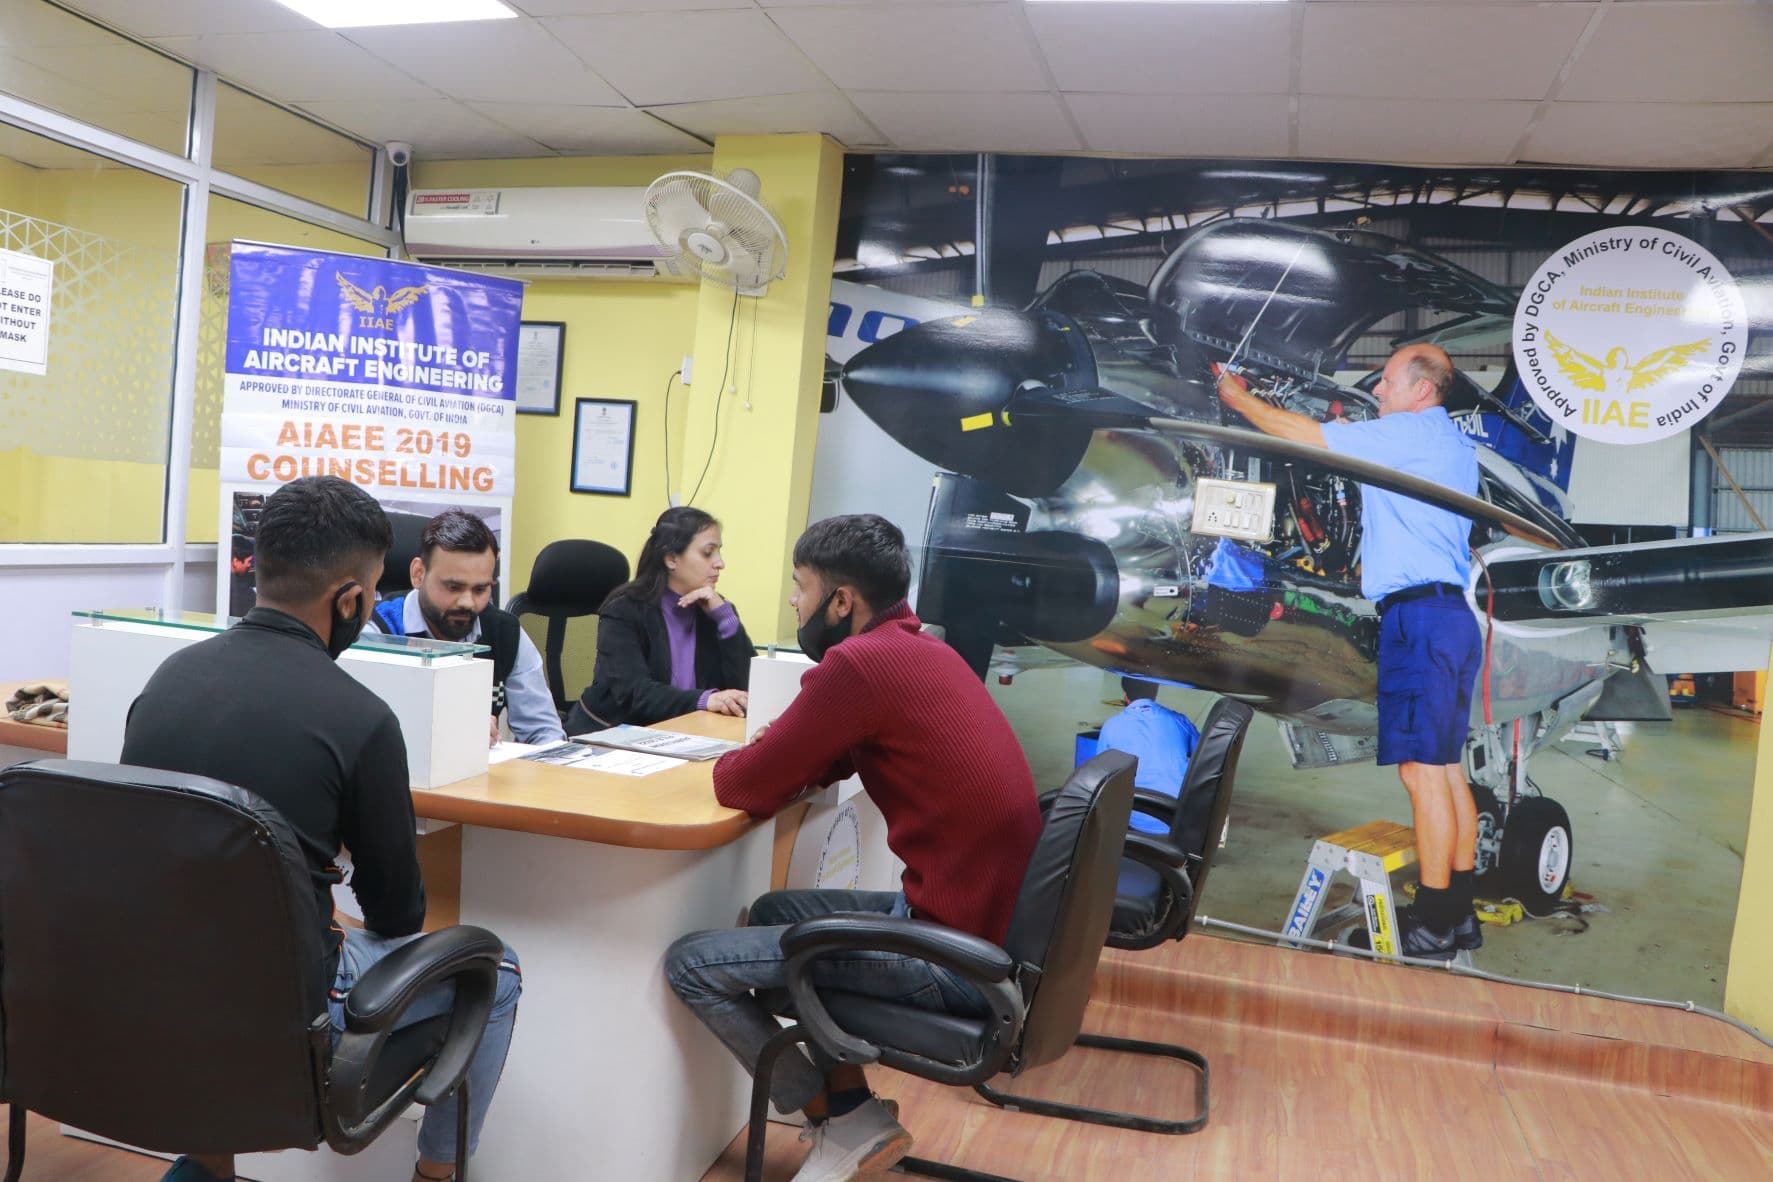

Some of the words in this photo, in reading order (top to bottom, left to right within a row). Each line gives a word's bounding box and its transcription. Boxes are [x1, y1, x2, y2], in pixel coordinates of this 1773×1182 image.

[1563, 237, 1633, 268] Ministry
[1639, 237, 1659, 250] of
[1662, 241, 1701, 268] Civil
[0, 287, 25, 300] EASE
[28, 293, 41, 303] DO
[1525, 271, 1565, 317] DGCA,
[1552, 299, 1568, 310] of
[1569, 300, 1621, 313] Aircraft
[1580, 284, 1623, 297] Indian
[1626, 287, 1685, 301] Institute
[1696, 265, 1736, 335] Aviation,
[0, 316, 36, 330] ITHOUT
[11, 304, 41, 317] ENTER
[359, 316, 394, 331] IIAE
[0, 330, 28, 342] MASK
[1521, 322, 1539, 342] by
[263, 328, 344, 352] INDIAN
[350, 336, 457, 365] INSTITUTE
[462, 350, 490, 368] OF
[244, 350, 359, 377] AIRCRAFT
[364, 359, 504, 392] ENGINEERING
[1523, 347, 1577, 418] Approved
[240, 380, 289, 394] APPROVED
[291, 385, 302, 395] BY
[305, 386, 365, 400] DIRECTORATE
[366, 390, 403, 403] GENERAL
[405, 394, 415, 404] OF
[418, 395, 438, 407] CIVIL
[439, 399, 475, 411] AVIATION
[477, 402, 504, 416] (DGCA)
[1697, 384, 1713, 403] of
[282, 399, 325, 412] MINISTRY
[328, 402, 340, 412] OF
[341, 403, 364, 414] CIVIL
[366, 404, 406, 419] AVIATION,
[408, 409, 431, 421] GOVT.
[433, 412, 444, 422] OF
[445, 413, 468, 424] INDIA
[1582, 398, 1651, 428] IIAE
[1656, 399, 1700, 427] India
[276, 420, 384, 451] AIAEE
[395, 427, 471, 458] 2019
[247, 453, 494, 492] COUNSELLING
